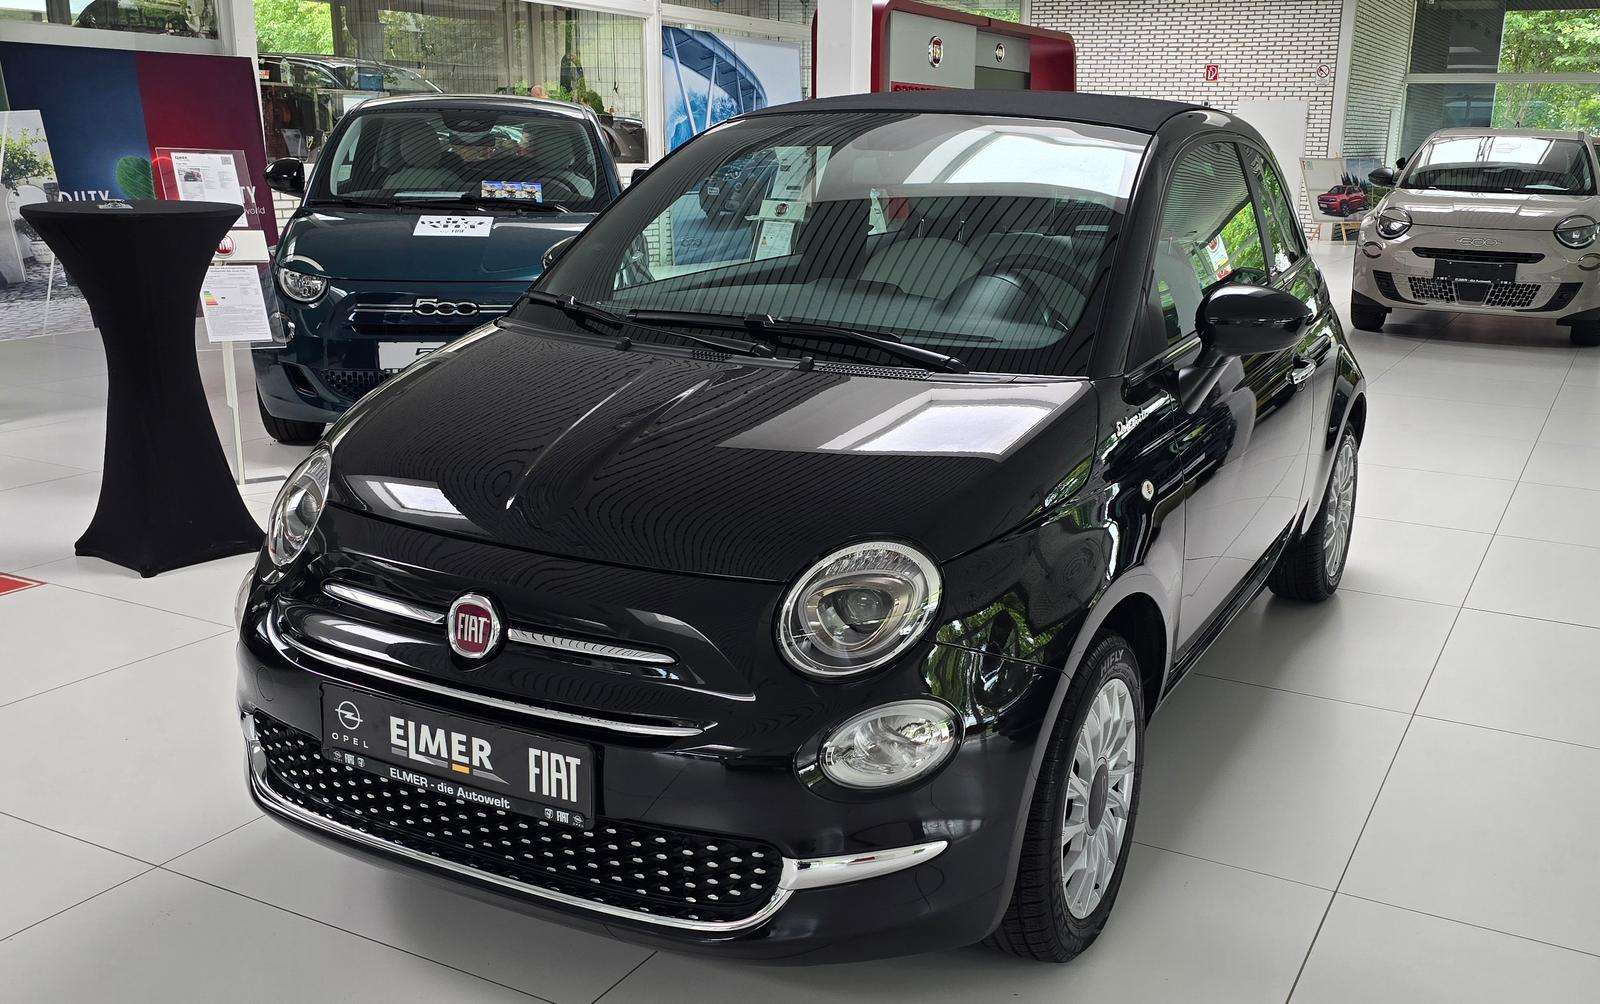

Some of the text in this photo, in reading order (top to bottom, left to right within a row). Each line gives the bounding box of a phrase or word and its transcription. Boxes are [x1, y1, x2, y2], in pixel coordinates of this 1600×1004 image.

[415, 298, 478, 316] 500
[457, 612, 490, 644] FIAT
[331, 732, 369, 749] OPEL
[389, 715, 494, 771] ELMER
[389, 767, 429, 788] ELMER
[437, 782, 454, 795] die
[456, 787, 511, 810] Autowelt
[528, 747, 581, 803] FIAT
